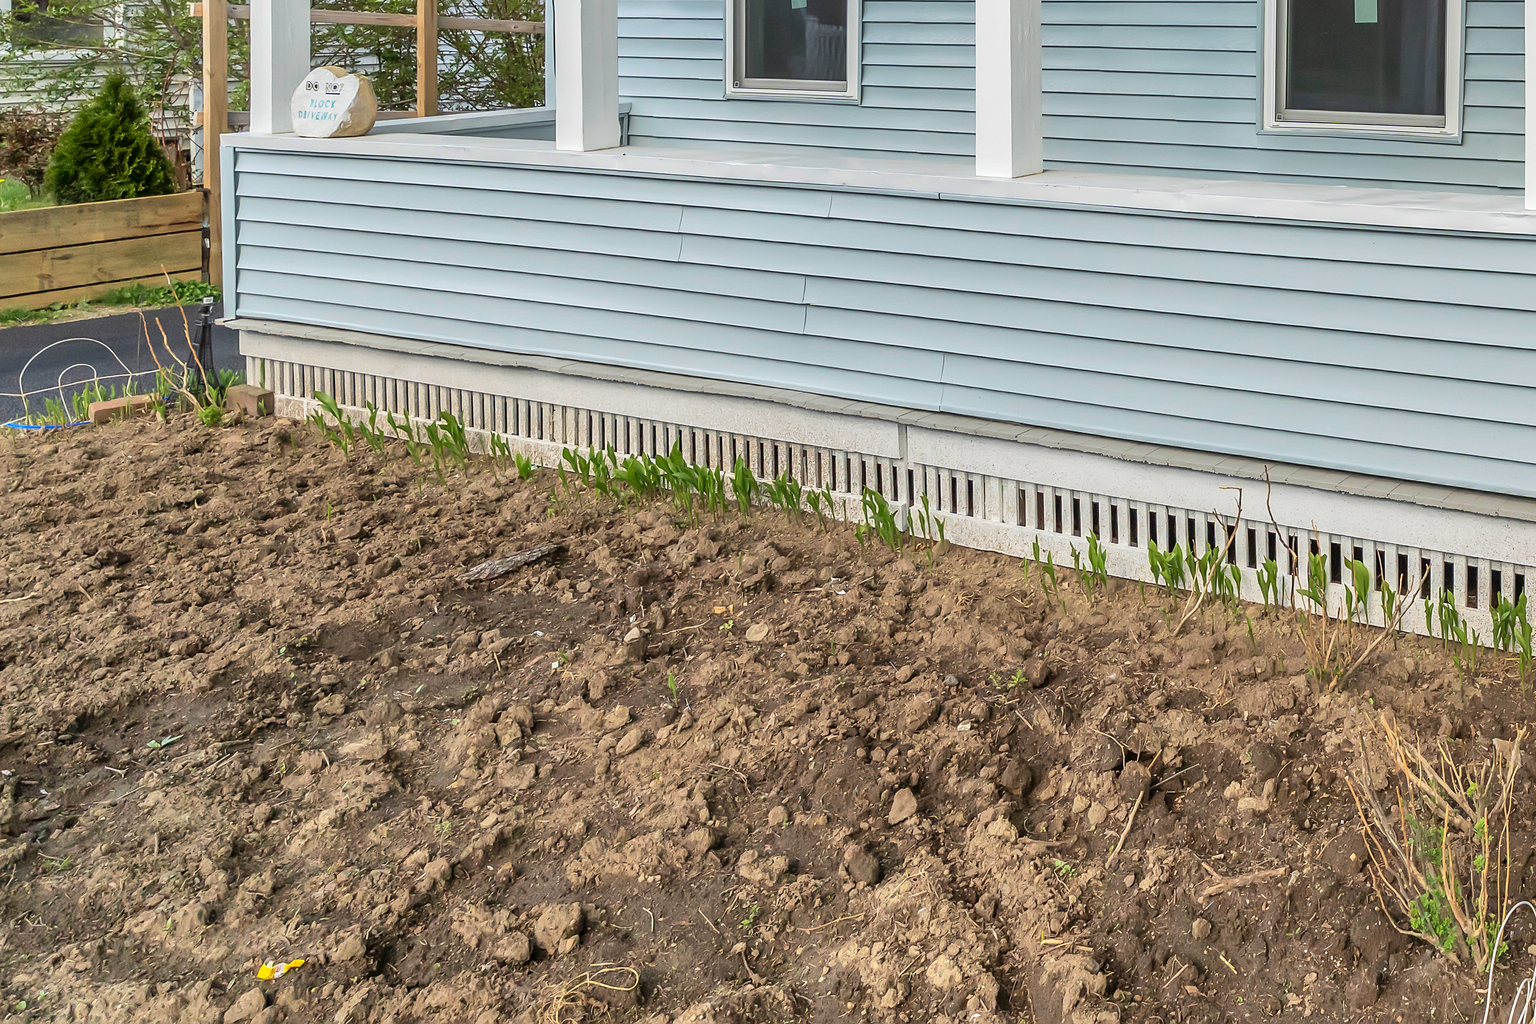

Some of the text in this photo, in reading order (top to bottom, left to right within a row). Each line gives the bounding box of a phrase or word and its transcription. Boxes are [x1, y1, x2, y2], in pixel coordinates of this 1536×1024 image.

[305, 80, 320, 92] DO
[309, 98, 337, 109] BLOCK
[298, 110, 339, 121] DRIVEWAY
